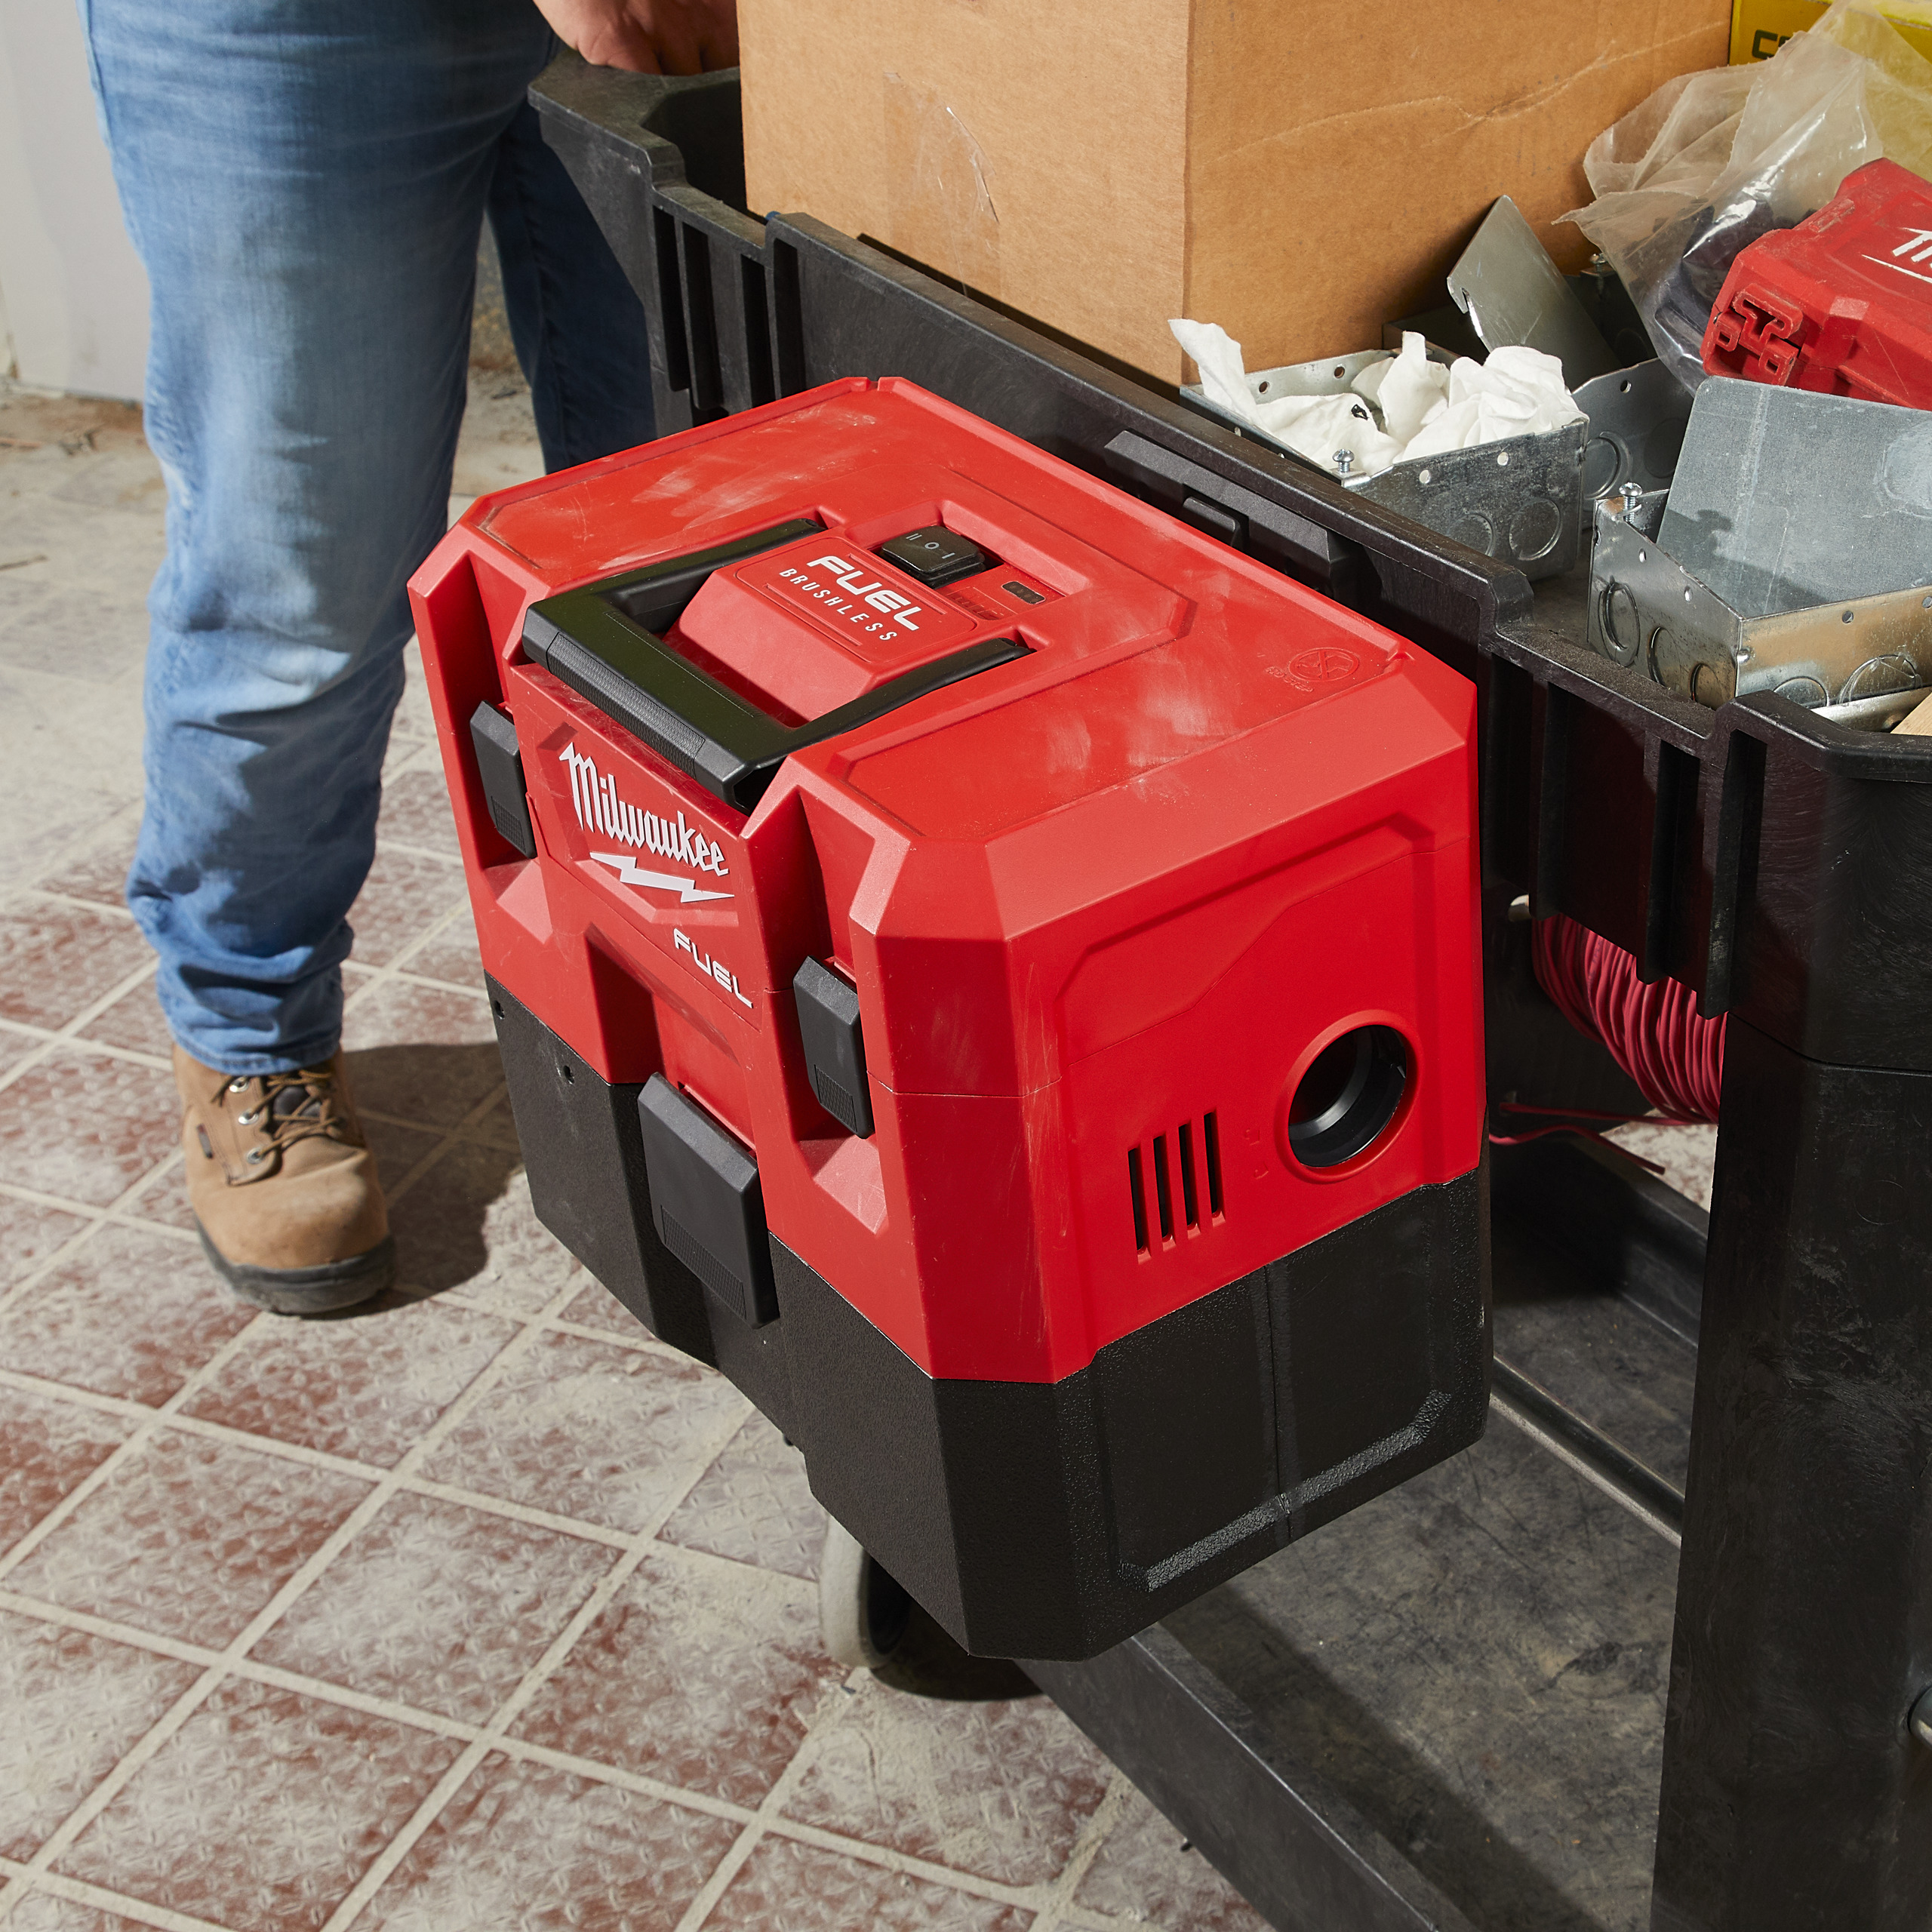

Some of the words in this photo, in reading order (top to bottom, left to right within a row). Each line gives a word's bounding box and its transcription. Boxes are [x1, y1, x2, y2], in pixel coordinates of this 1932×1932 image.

[779, 568, 898, 641] BRUSHLESS
[806, 555, 920, 632] FUEL
[559, 742, 729, 876] Milwaukee
[673, 928, 753, 1009] FUEL
